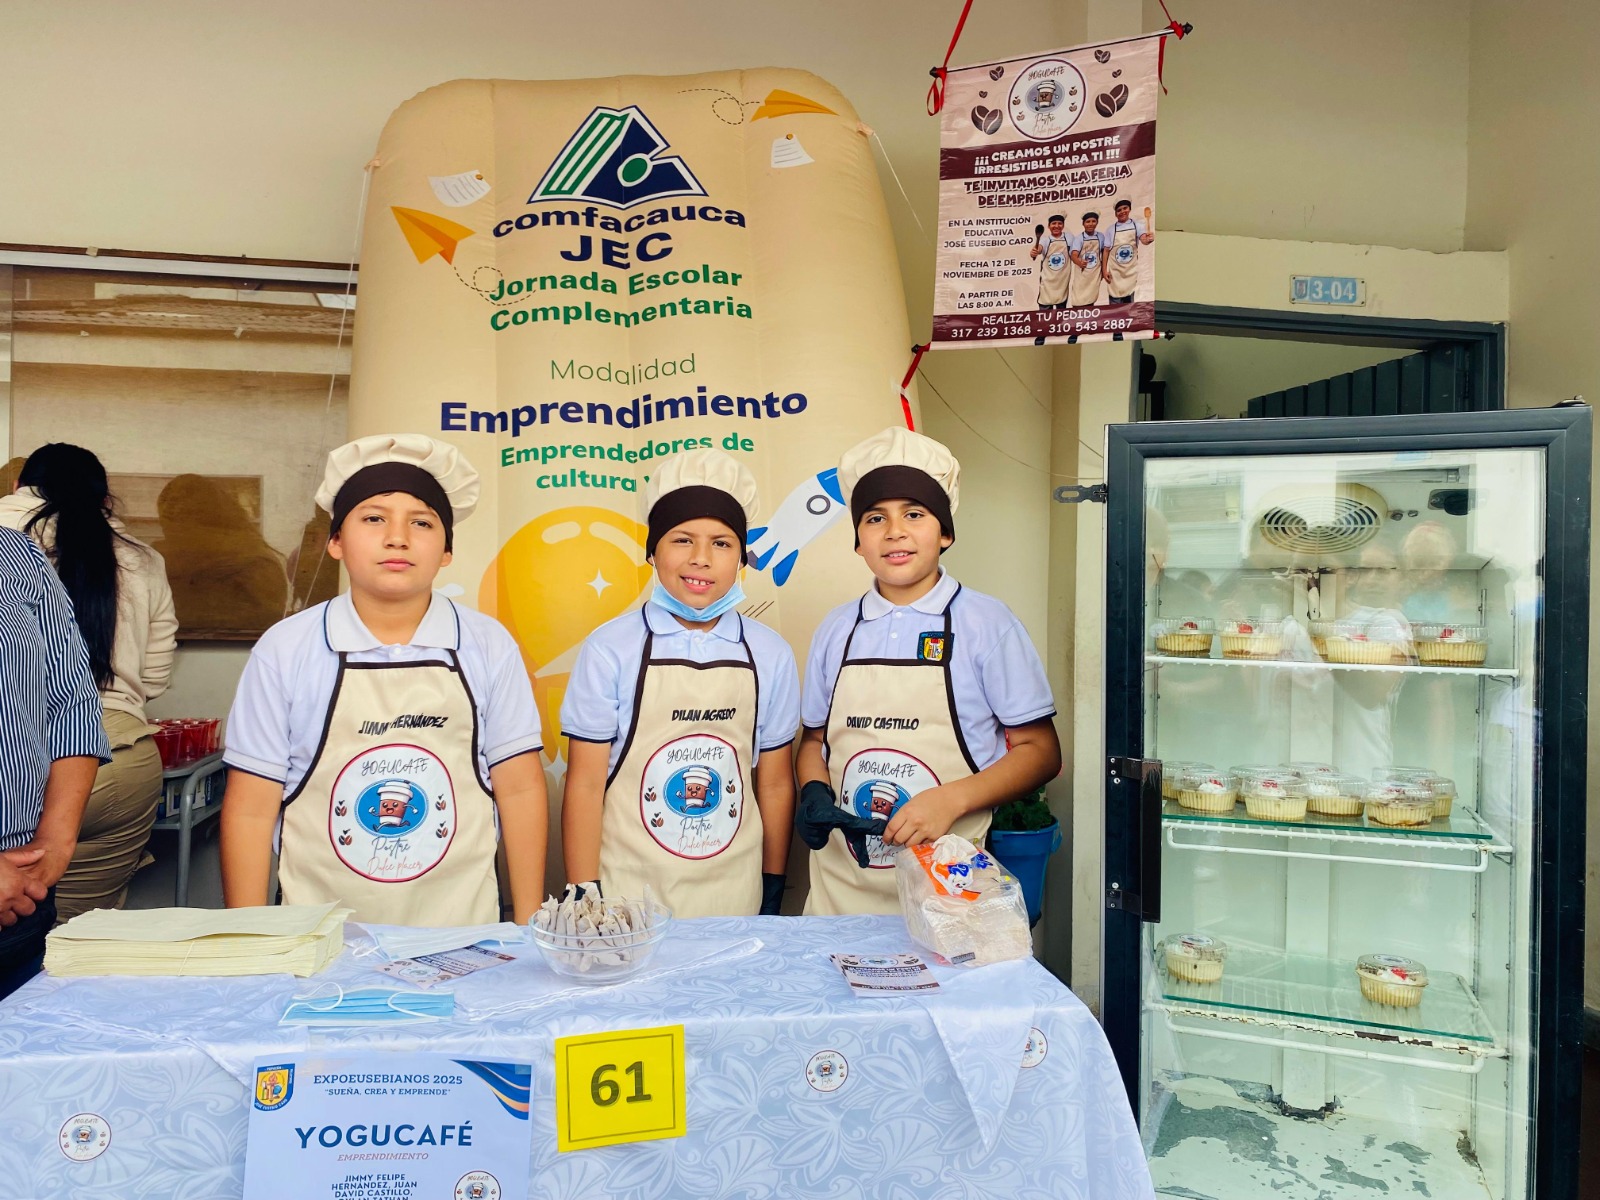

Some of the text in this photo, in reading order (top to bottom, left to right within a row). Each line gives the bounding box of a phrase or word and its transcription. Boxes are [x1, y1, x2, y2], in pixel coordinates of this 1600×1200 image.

[991, 148, 1051, 162] CREAMOS
[1053, 144, 1070, 154] UN
[1073, 135, 1121, 150] POSTRE
[974, 148, 1121, 175] IRRESISTIBLE PARA TI !!!
[964, 165, 1131, 192] TE INVITAMOS A LA FERIA
[978, 183, 1117, 207] DE EMPRENDIMIENTO
[493, 205, 746, 238] comfacauca
[976, 216, 1031, 226] INSTITUCIÓN
[944, 237, 1034, 248] JOSÉ EUSEBIO CARO
[965, 229, 1014, 237] EDUCATIVA
[560, 232, 673, 270] JEC
[489, 264, 742, 301] Jornada Escolar
[943, 271, 995, 279] NOVIEMBRE
[1012, 268, 1032, 276] 2025
[968, 290, 999, 298] PARTIR
[490, 295, 753, 331] Complementaria
[982, 308, 1100, 326] REALIZA TU PEDIDO
[951, 328, 972, 338] 317
[977, 327, 998, 337] 239
[1003, 325, 1031, 336] 1368
[1048, 323, 1071, 333] 310
[1076, 321, 1098, 331] 543
[1103, 318, 1133, 330] 2887
[551, 353, 696, 386] Modalidad
[440, 386, 808, 438] Emprendimiento
[501, 432, 755, 467] Emprendedores de
[536, 468, 637, 493] cultura
[672, 709, 702, 721] DILAN
[847, 716, 920, 730] DAVID CASTILLO
[667, 746, 726, 764] YOGUCAFE
[361, 758, 430, 777] YOGUCAFE
[858, 759, 918, 778] YOGUCAFE
[680, 817, 712, 838] Postre
[372, 836, 411, 859] Postre
[677, 835, 701, 854] Dulce
[367, 856, 423, 877] Dulce placer
[313, 1074, 463, 1085] EXPOEUSEBIANOS 2025
[590, 1061, 652, 1107] 61
[294, 1120, 473, 1149] YOGUCAFÉ
[337, 1153, 429, 1162] EMPRENDIMIENTO
[331, 1181, 391, 1190] HERNÁNDEZ,
[345, 1174, 374, 1182] JIMMY
[335, 1189, 413, 1198] DAVID CASTILLO,
